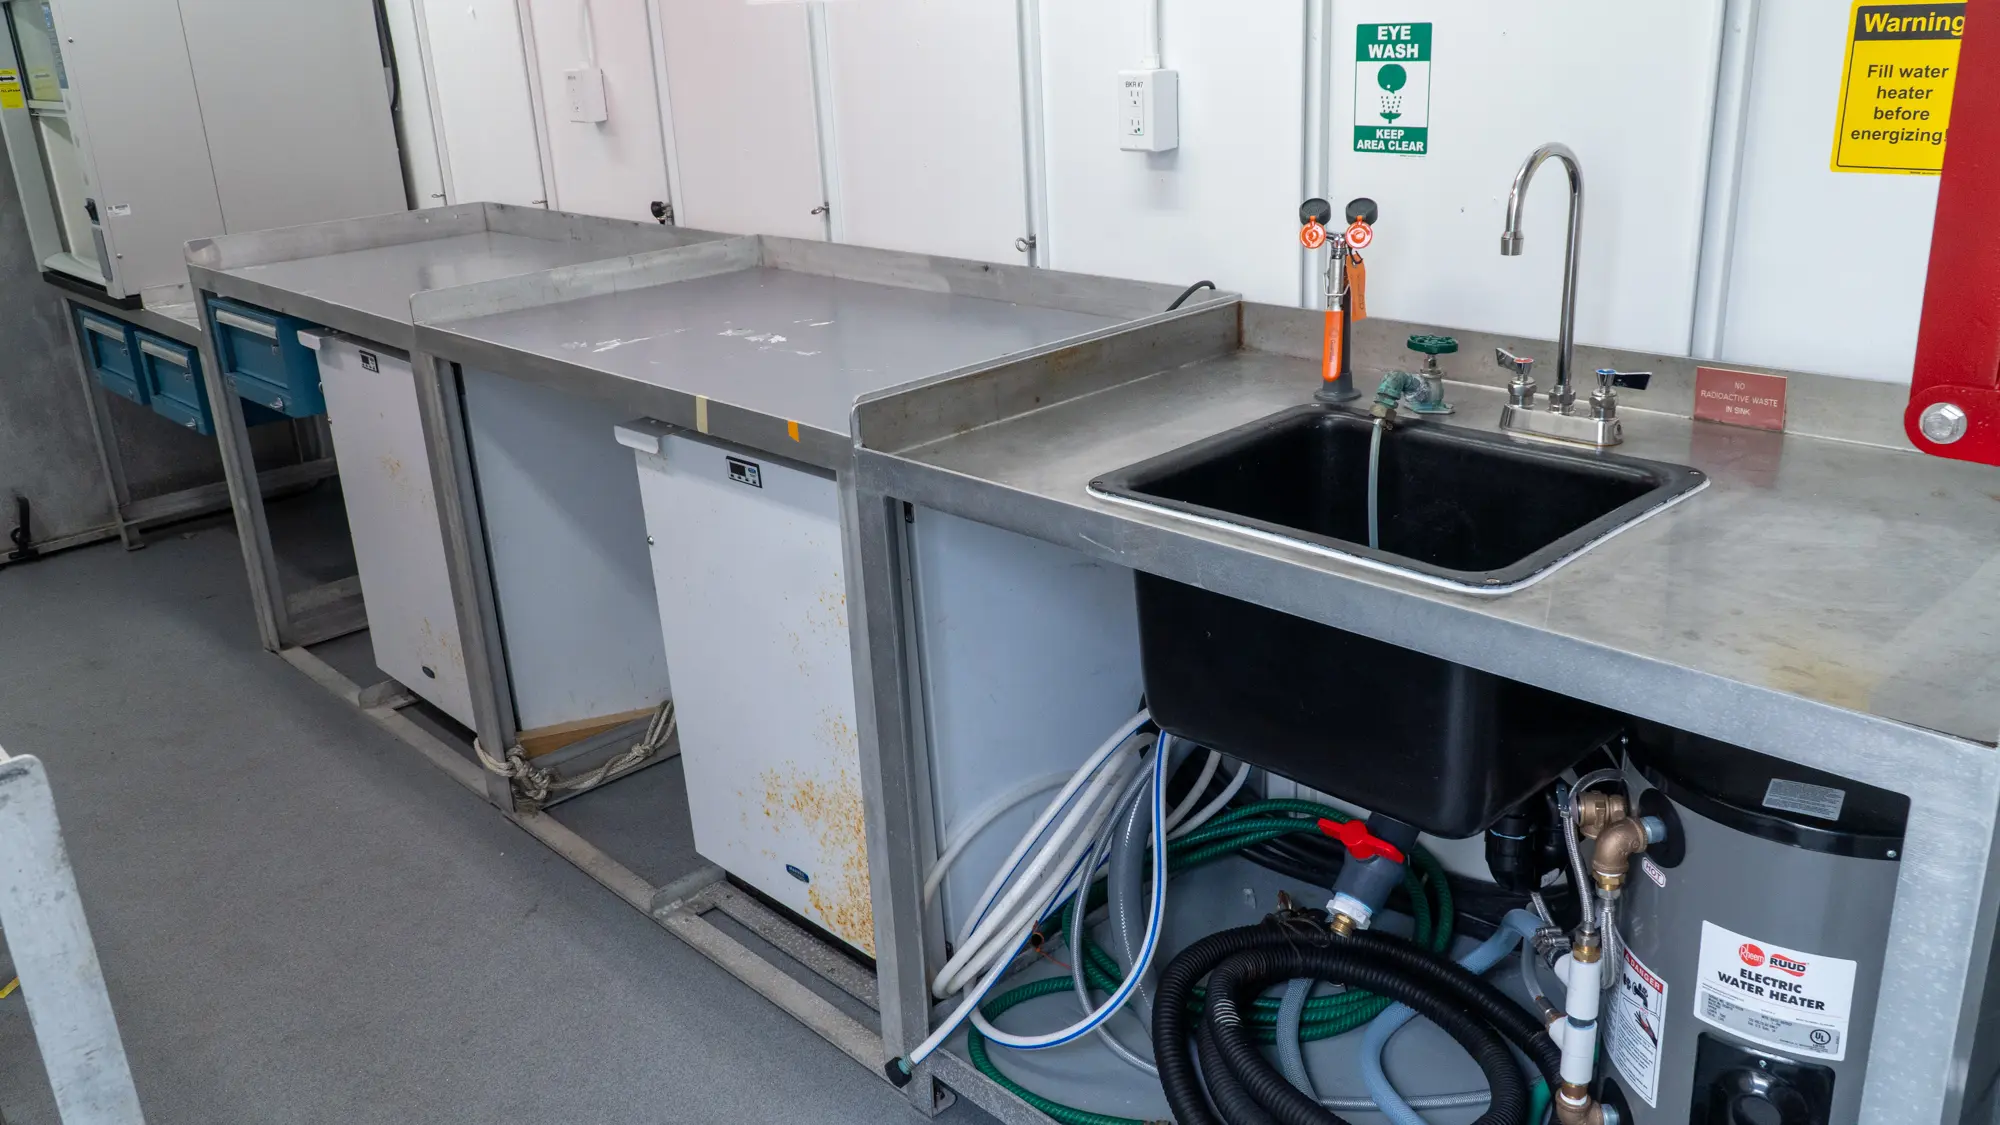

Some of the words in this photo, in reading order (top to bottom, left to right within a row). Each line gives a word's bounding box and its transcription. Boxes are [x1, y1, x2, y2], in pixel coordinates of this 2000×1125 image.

[1864, 12, 1966, 36] Warning
[1377, 25, 1411, 40] EYE
[1368, 43, 1419, 58] WASH
[1867, 64, 1894, 78] Fill
[1899, 64, 1949, 78] water
[1876, 86, 1933, 100] heater
[1873, 106, 1930, 120] before
[1376, 129, 1404, 140] KEEP
[1356, 139, 1385, 150] AREA
[1388, 140, 1424, 152] CLEAR
[1734, 382, 1746, 390] NO
[1700, 389, 1750, 404] RADIOACTIVE
[1752, 397, 1778, 408] WASTE
[1725, 405, 1733, 413] IN
[1734, 406, 1751, 416] SINK
[1645, 862, 1661, 880] HOT
[1740, 944, 1765, 962] Rheem
[1769, 957, 1806, 972] RUUD
[1630, 959, 1661, 991] DANGER
[1740, 968, 1802, 994] ELECTRIC
[1717, 970, 1764, 996] WATER
[1769, 989, 1825, 1011] HEATER
[1814, 1031, 1826, 1043] UL
